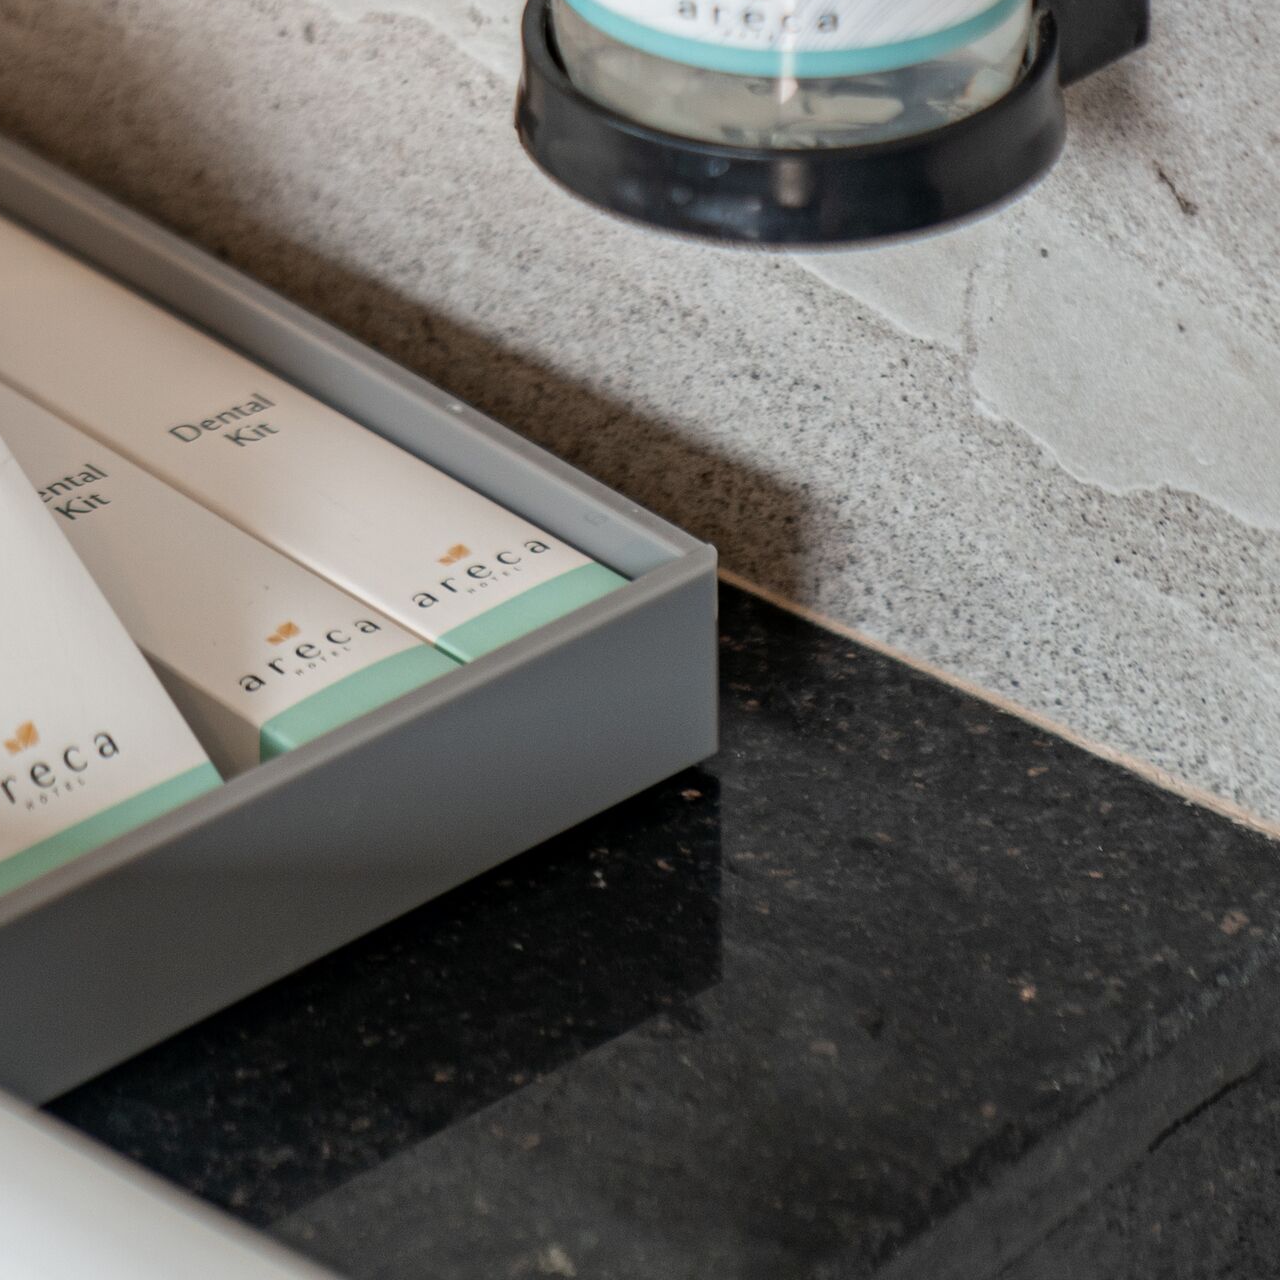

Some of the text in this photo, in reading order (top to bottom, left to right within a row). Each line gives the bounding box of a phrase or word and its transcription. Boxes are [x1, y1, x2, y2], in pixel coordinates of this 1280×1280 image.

[168, 392, 277, 443] Dental
[222, 421, 280, 448] Kit
[37, 462, 109, 504] ental
[54, 493, 111, 521] Kit
[411, 538, 552, 609] areca
[238, 618, 382, 693] areca
